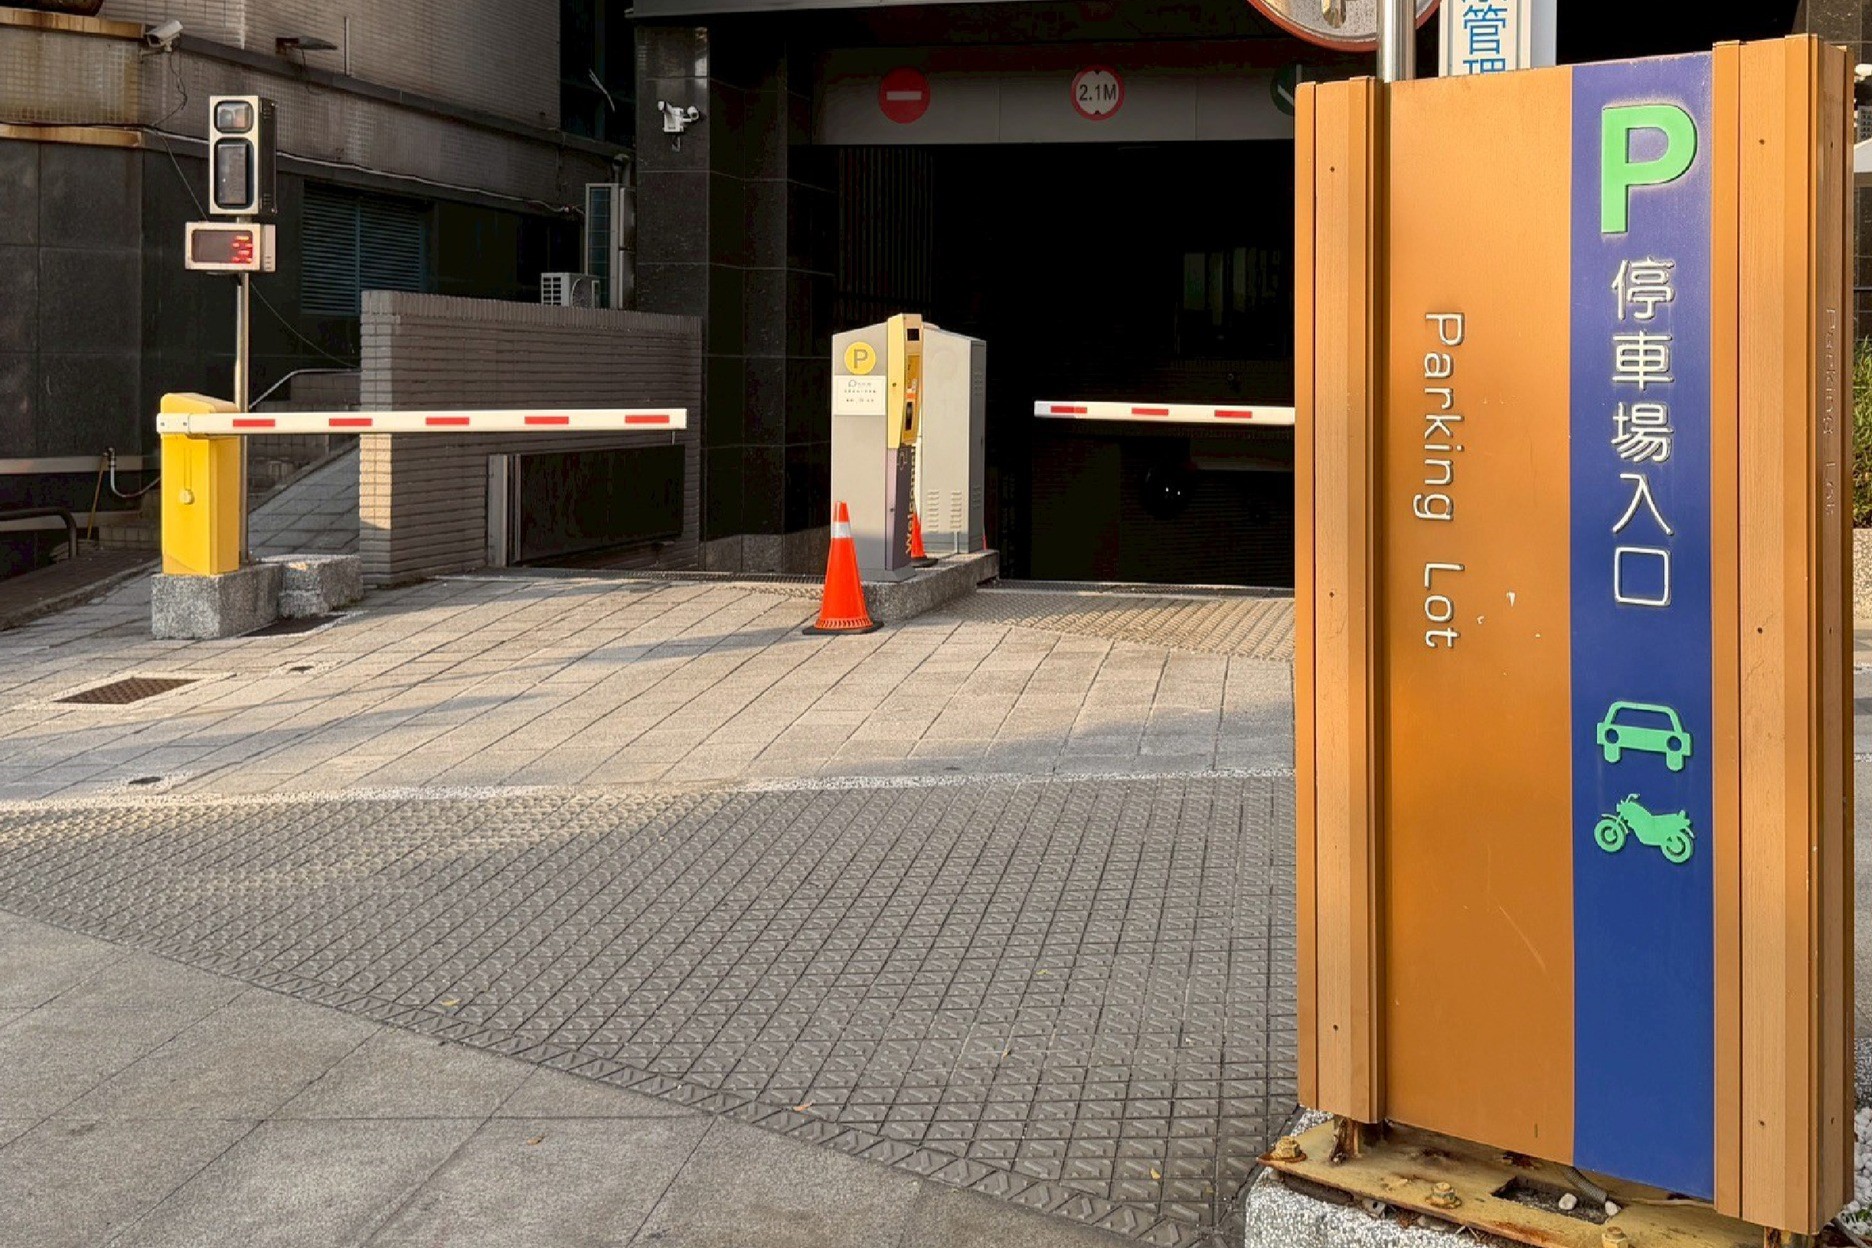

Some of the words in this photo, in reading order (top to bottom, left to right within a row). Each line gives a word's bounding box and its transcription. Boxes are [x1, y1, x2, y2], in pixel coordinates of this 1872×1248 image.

[1079, 83, 1117, 101] 2.1M
[1601, 103, 1698, 233] P
[853, 349, 868, 368] P
[1413, 311, 1465, 521] Parking
[1611, 256, 1675, 606] 停車場入口
[1424, 563, 1465, 648] Lot
